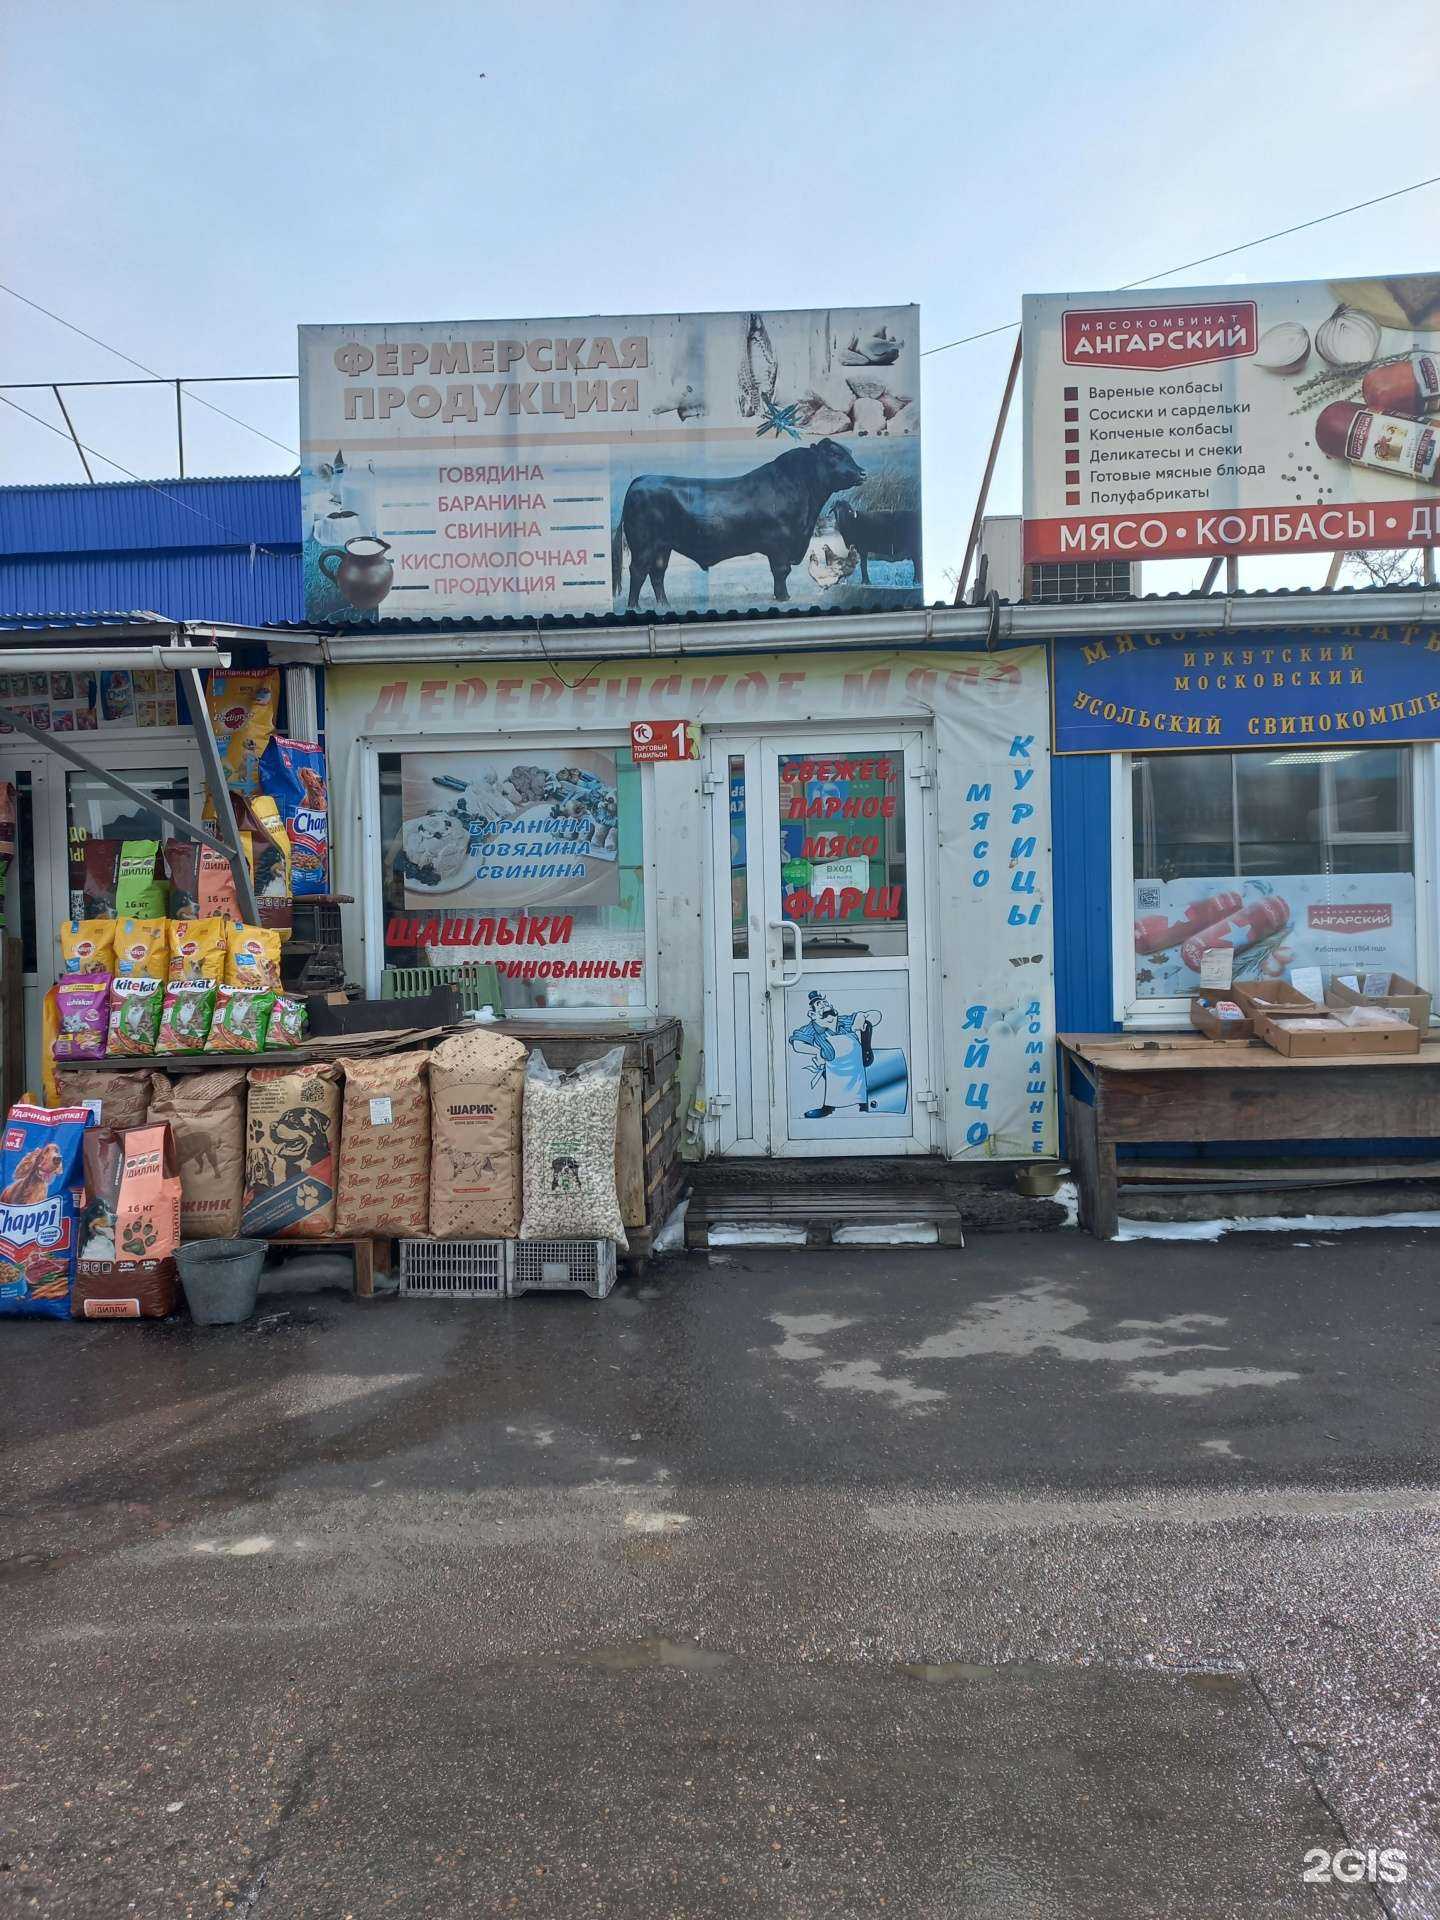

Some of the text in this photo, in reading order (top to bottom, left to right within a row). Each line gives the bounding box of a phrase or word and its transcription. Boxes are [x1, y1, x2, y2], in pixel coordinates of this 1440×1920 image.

[1081, 314, 1238, 331] МЯСОКОМБИНАТ
[1074, 325, 1247, 355] АНГАРСКИЙ
[333, 335, 650, 376] ФЕРМЕРСКАЯ
[1089, 381, 1224, 399] Вареные колбасы
[343, 378, 640, 424] ПРОДУКЦИЯ
[1089, 402, 1250, 420] Сосиски и сардельки
[1090, 423, 1233, 441] Копченые колбасы
[1090, 444, 1242, 464] Деликатесы и снеки
[439, 464, 544, 484] ГОВЯДИНА
[1090, 463, 1265, 483] Готовые мясные блюда
[438, 493, 546, 513] БАРАНИНА
[1091, 487, 1209, 505] Полуфабрикаты
[445, 520, 541, 539] СВИНИНА
[1060, 520, 1167, 552] МЯСО
[1197, 510, 1374, 545] КОЛБАСЫ
[400, 549, 588, 571] КИСЛОМОЛОЧНАЯ
[434, 576, 556, 596] ПРОДУКЦИЯ
[1183, 644, 1355, 668] ИРКУТСКИЙ
[1174, 668, 1366, 691] МОСКОВСКИЙ
[363, 671, 806, 731] ДЕРЕВЕНСКОЕ
[1072, 690, 1222, 735] УСОЛЬСКИЙ
[634, 744, 668, 752] ТОРГОВЫЙ
[672, 722, 685, 757] 1
[782, 759, 897, 783] СВЕЖЕЕ,
[789, 796, 897, 819] ПАРНОЕ
[469, 818, 592, 836] БАРАНИНА
[966, 783, 992, 889] МЯСО
[1007, 734, 1042, 927] КУРИЦЫ
[469, 841, 592, 857] ГОВЯДИНА
[801, 835, 880, 858] МЯСО
[475, 864, 588, 880] СВИНИНА
[826, 865, 853, 873] ВХОД
[208, 895, 231, 904] 16 кг
[784, 886, 903, 920] ФАРШ
[1311, 914, 1391, 926] АНГАРСКИЙ
[386, 915, 574, 947] ШАШЛЫКИ
[463, 959, 642, 979] РИНОВАННЫЕ
[115, 979, 156, 993] kitekat
[169, 979, 211, 990] kitekat
[961, 1005, 992, 1147] ЯЙЦО
[1024, 1001, 1046, 1154] ДОМАШНЕЕ
[11, 1108, 84, 1122] Удачная покупка!
[450, 1104, 493, 1115] ШАРИК
[128, 1204, 155, 1213] 16 кг
